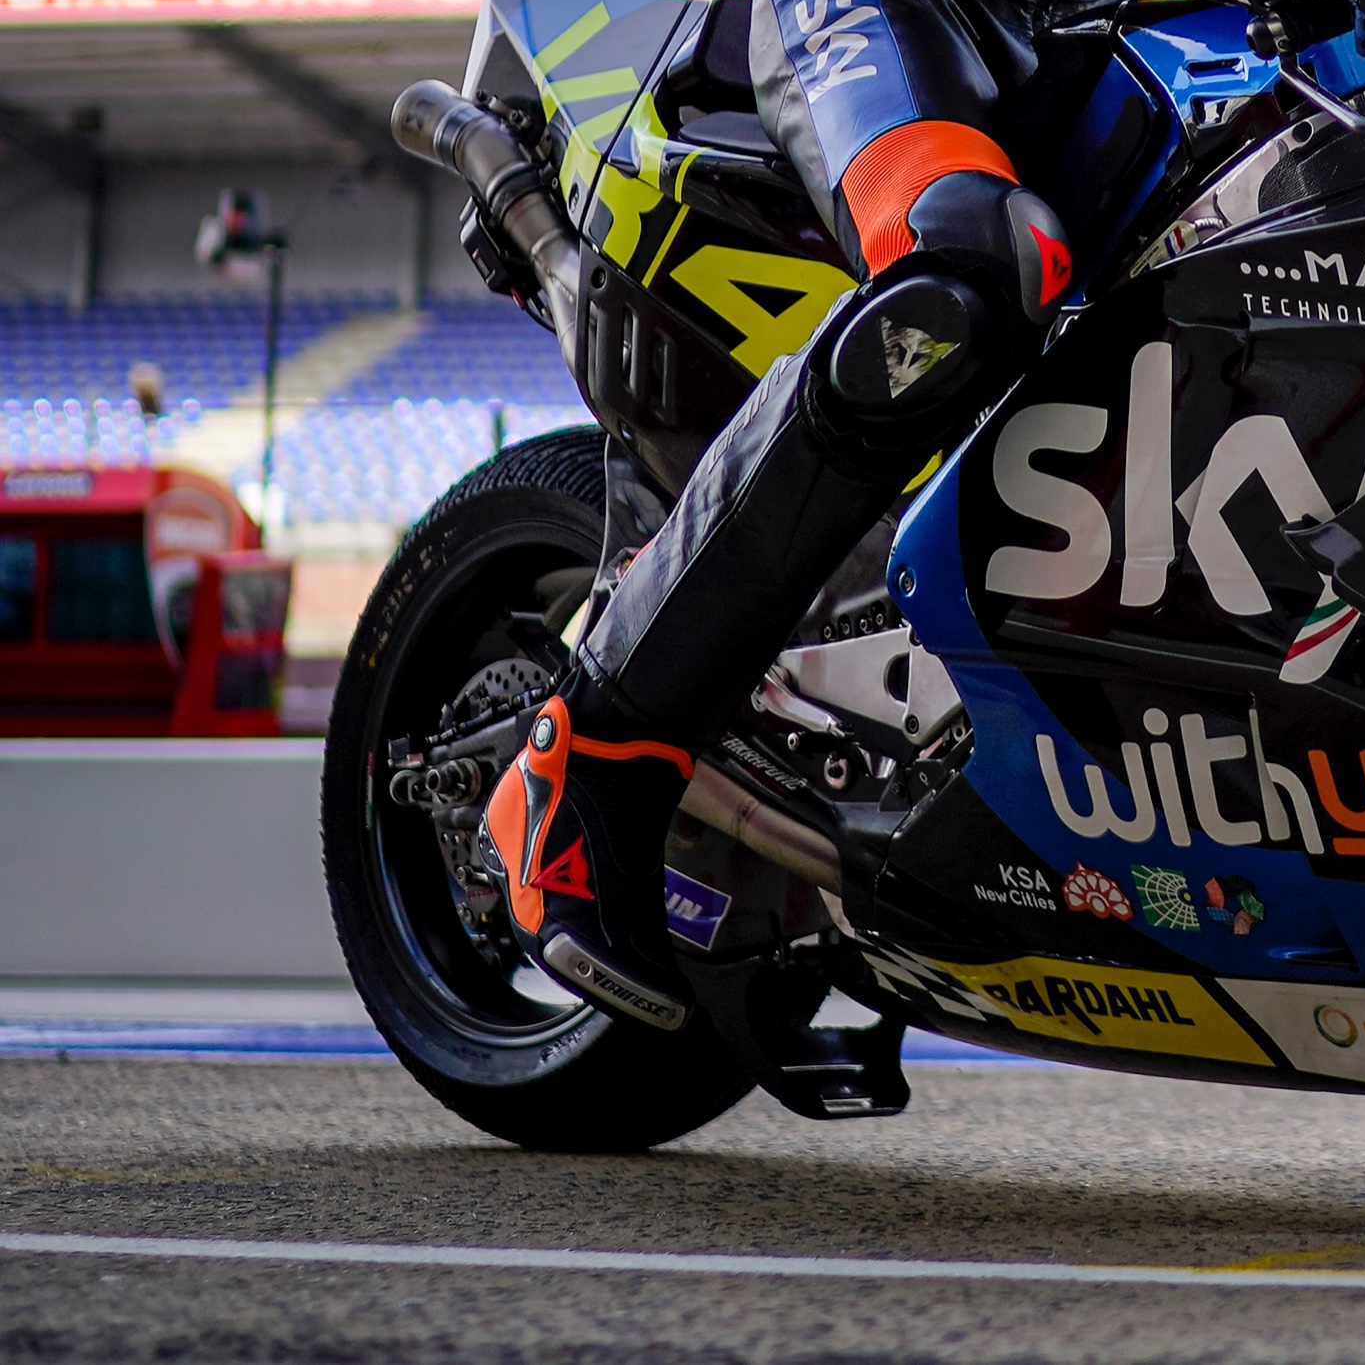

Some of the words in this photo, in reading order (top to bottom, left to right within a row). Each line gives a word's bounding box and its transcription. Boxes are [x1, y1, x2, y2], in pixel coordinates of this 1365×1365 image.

[998, 862, 1051, 893] KSA
[974, 883, 1007, 904] New
[1009, 889, 1057, 912] Cities
[599, 976, 669, 1017] DAINESE
[984, 976, 1195, 1035] BARDAHL
